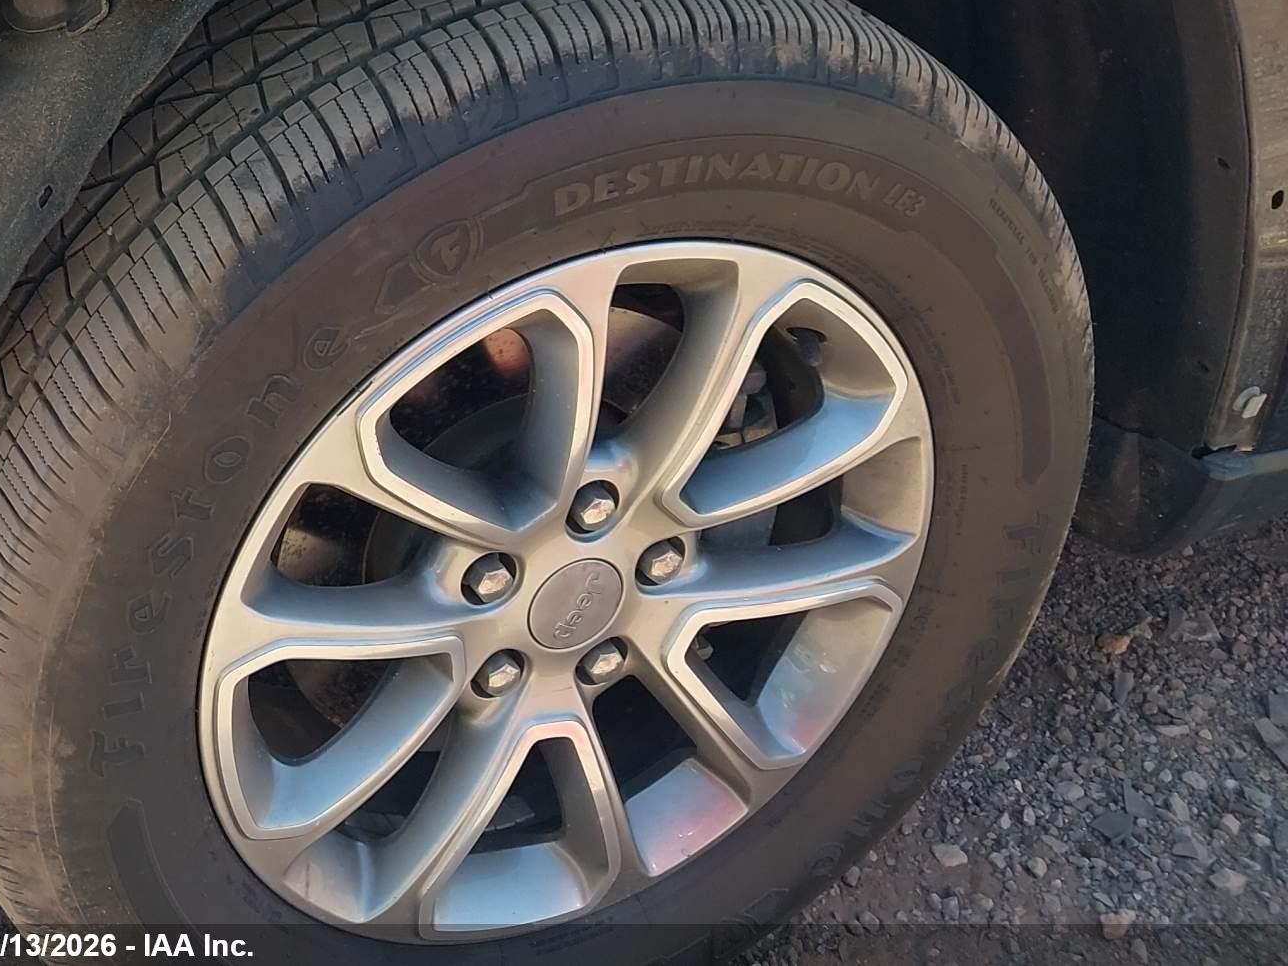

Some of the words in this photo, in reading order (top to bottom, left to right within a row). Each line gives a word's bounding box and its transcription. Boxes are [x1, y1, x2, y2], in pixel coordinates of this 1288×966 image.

[552, 153, 881, 217] DESTINATION
[883, 183, 928, 219] LE3
[90, 325, 349, 778] Firestone
[554, 571, 603, 638] Jeep
